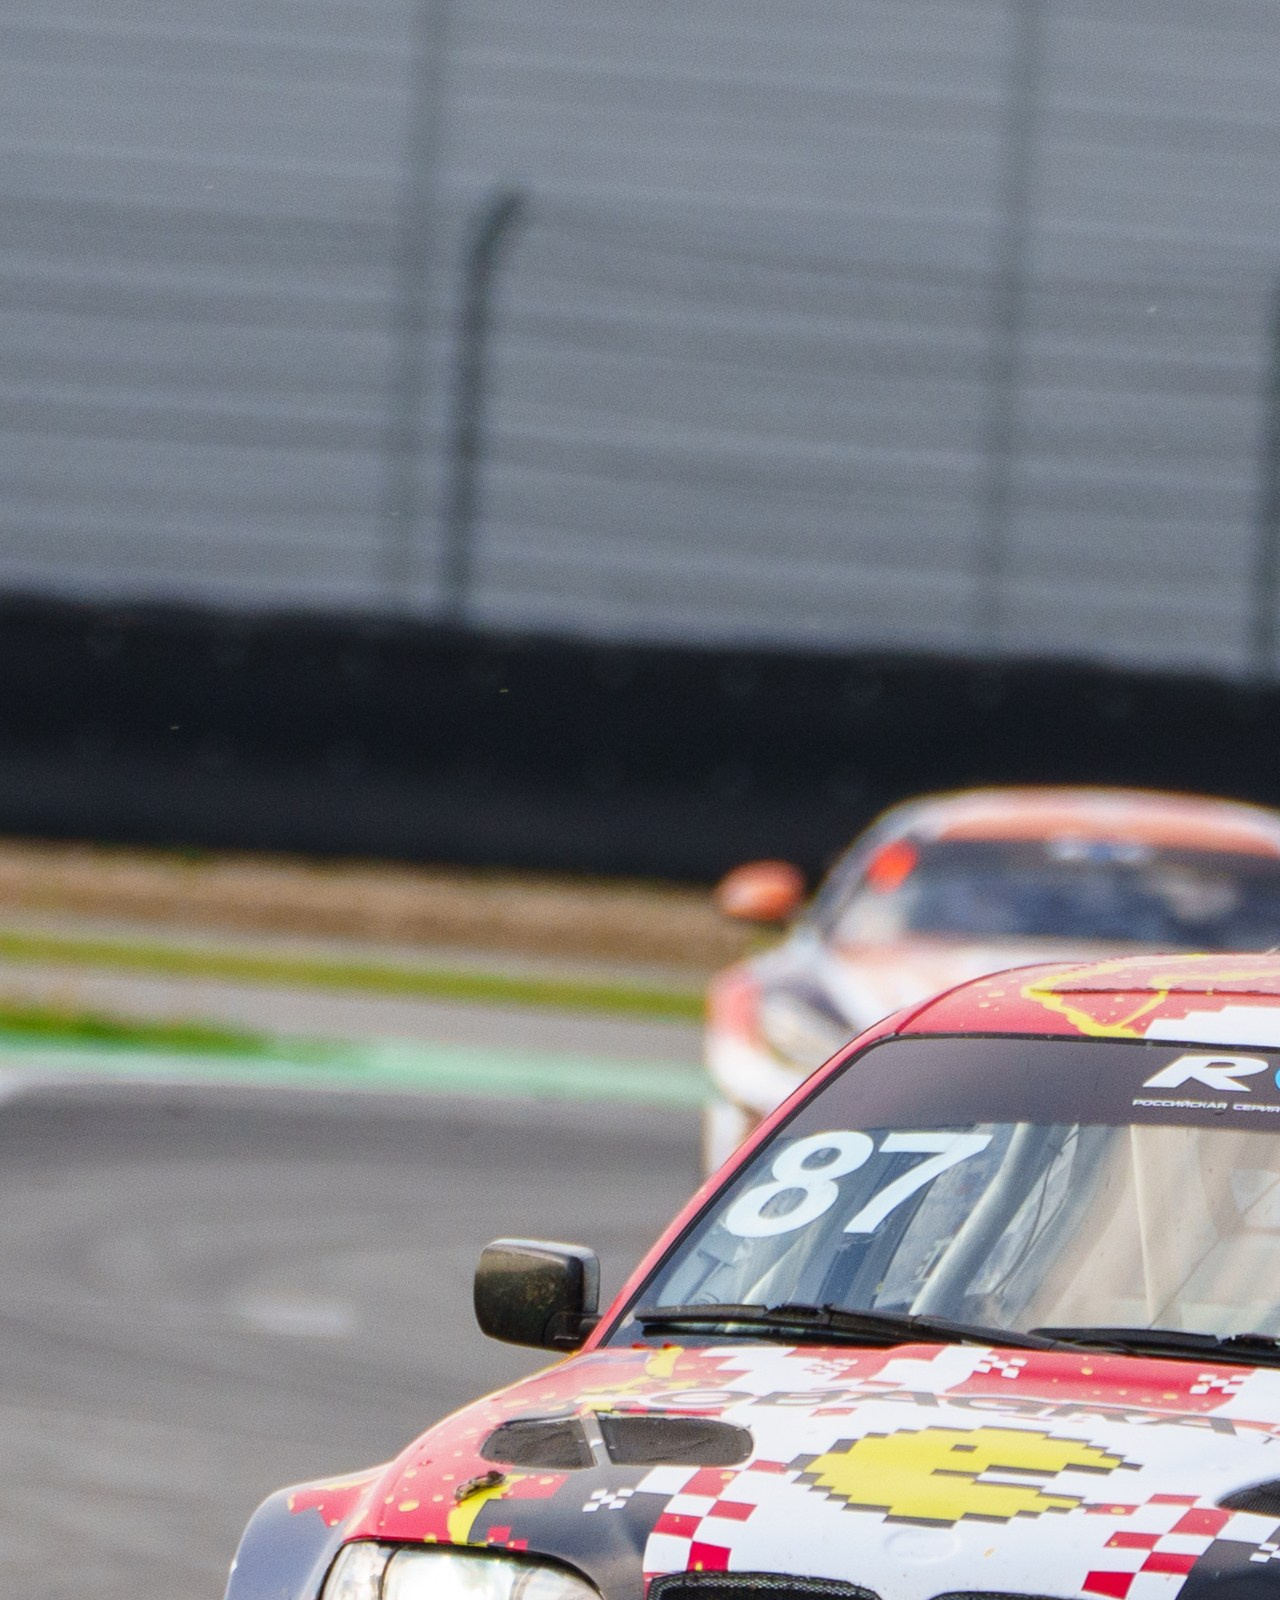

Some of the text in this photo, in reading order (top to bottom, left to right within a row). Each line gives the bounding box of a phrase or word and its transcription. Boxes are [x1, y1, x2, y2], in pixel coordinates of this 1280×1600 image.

[1132, 1098, 1228, 1111] РОССИЙСКАЯ
[725, 1130, 994, 1238] 87
[650, 1388, 1238, 1436] OBAGRA
